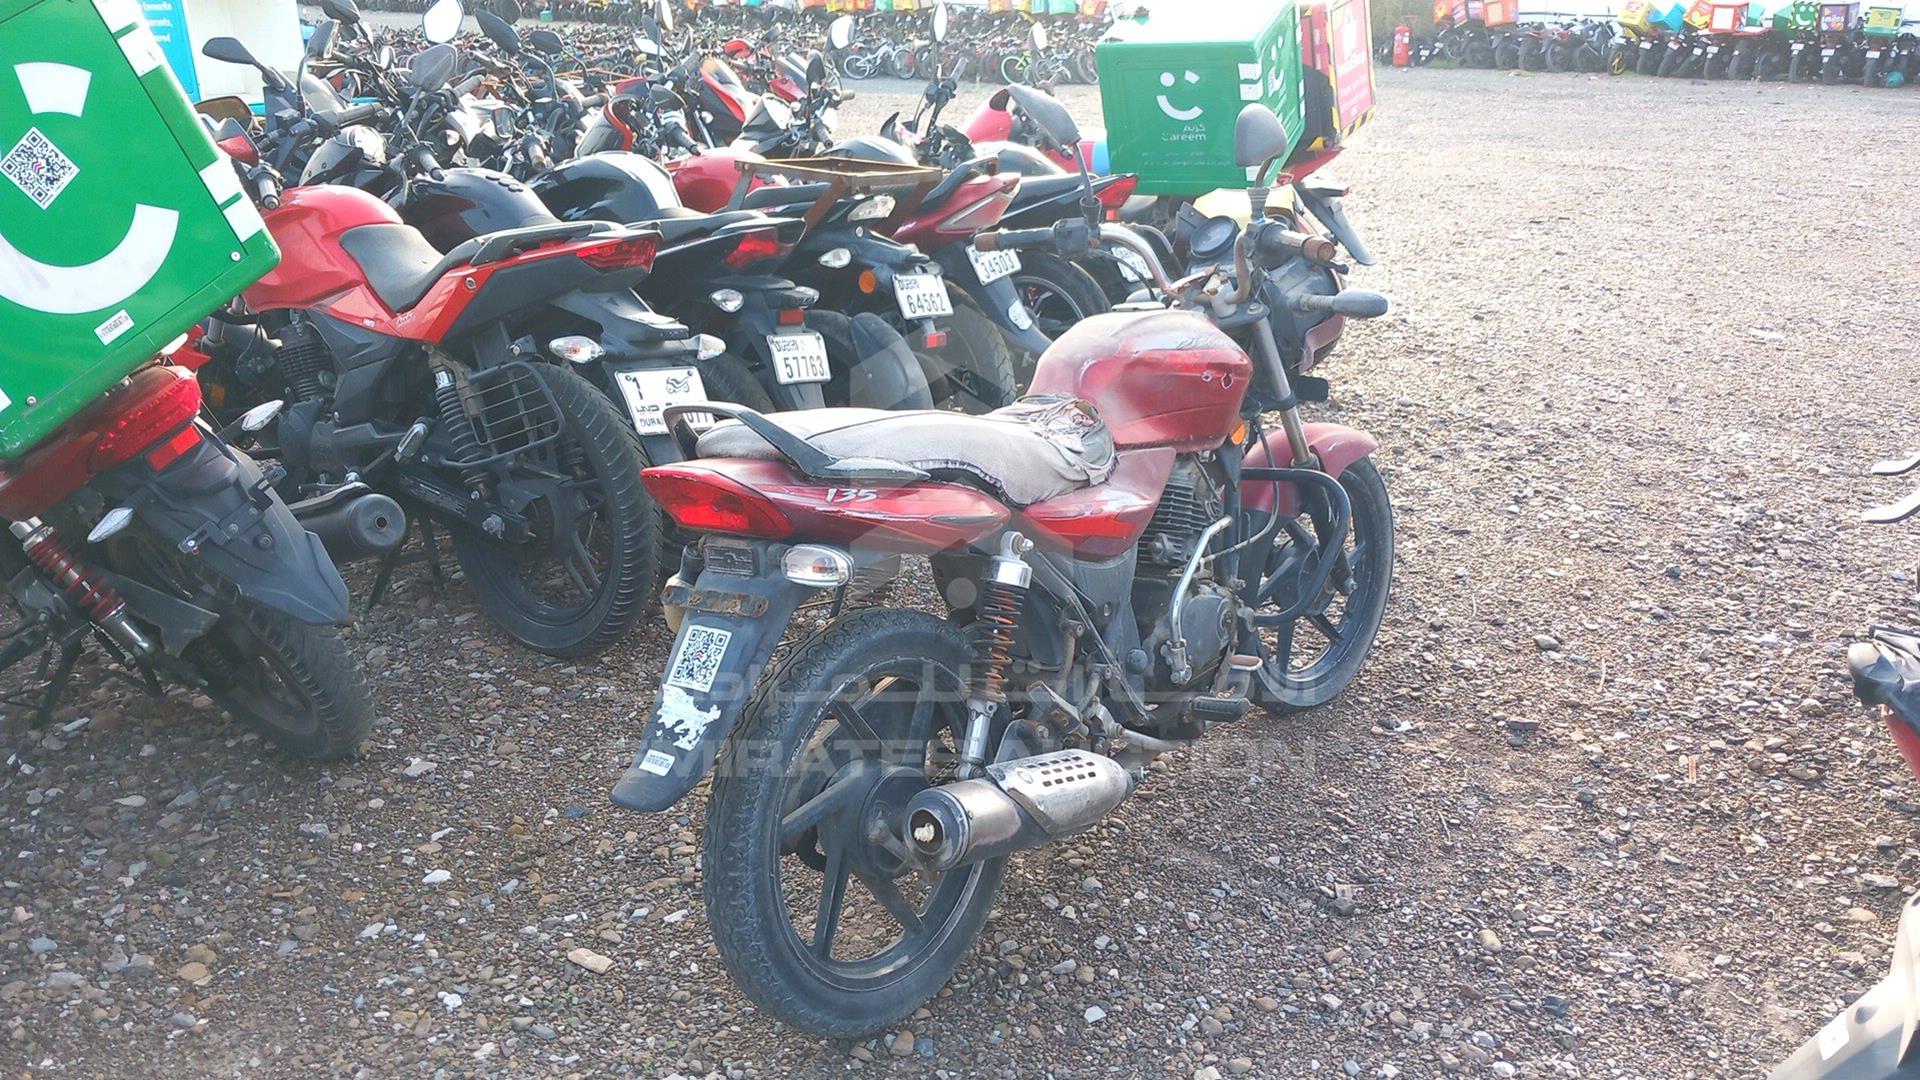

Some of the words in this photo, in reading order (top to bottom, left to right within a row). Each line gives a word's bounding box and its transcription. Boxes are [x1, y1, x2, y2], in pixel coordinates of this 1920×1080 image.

[980, 252, 1015, 280] 34503
[906, 292, 946, 315] 64562
[783, 354, 825, 379] 57763
[631, 377, 644, 401] 1
[825, 487, 878, 503] 135
